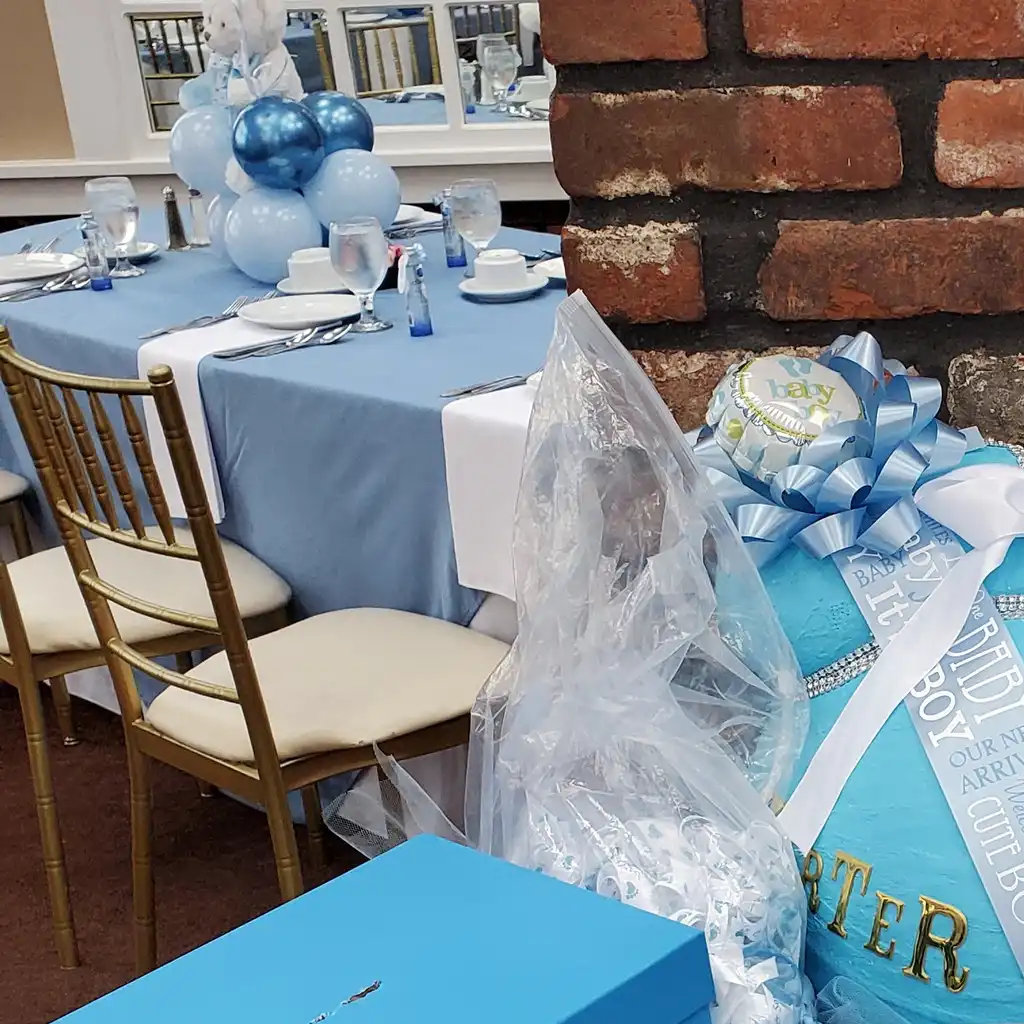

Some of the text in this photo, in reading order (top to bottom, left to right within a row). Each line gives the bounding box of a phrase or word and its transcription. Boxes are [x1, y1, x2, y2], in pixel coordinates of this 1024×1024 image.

[766, 378, 836, 404] baby
[852, 547, 908, 588] BABY
[904, 533, 942, 581] aby
[909, 662, 975, 748] BOY
[950, 738, 999, 769] OUR
[967, 796, 1021, 866] CUTE
[801, 847, 971, 994] RTER
